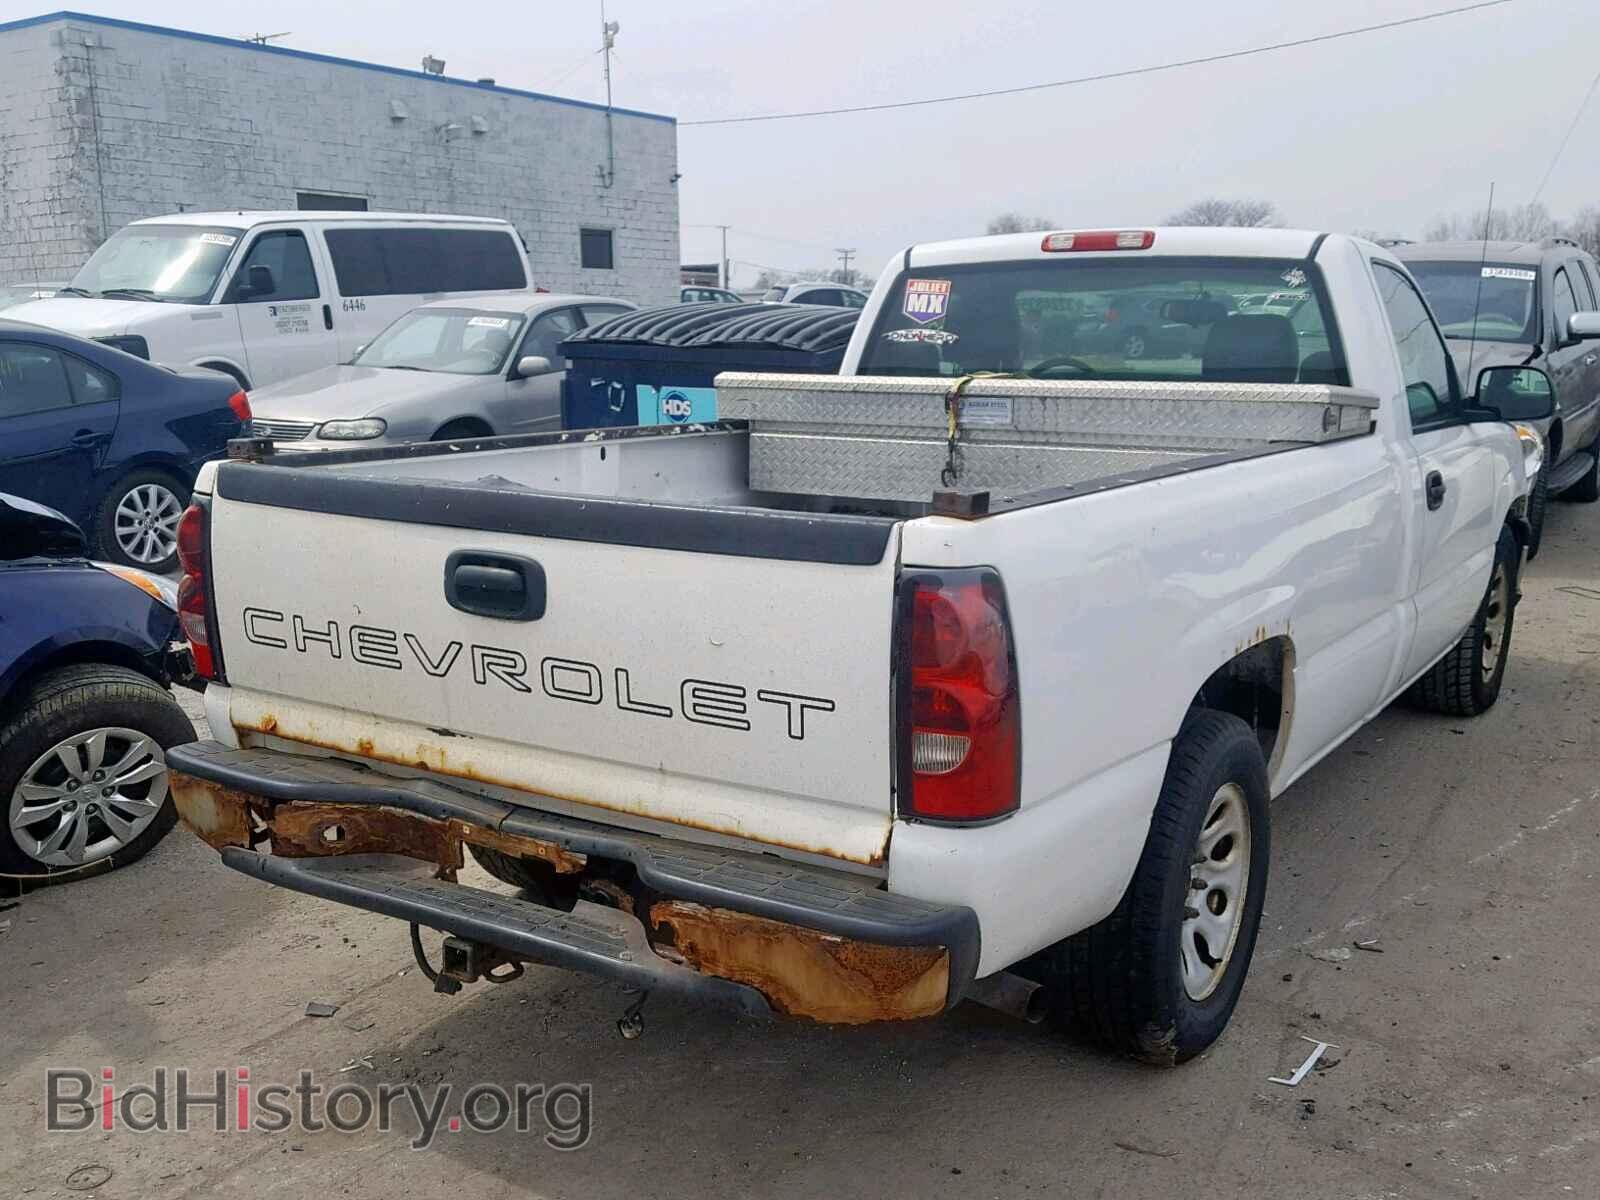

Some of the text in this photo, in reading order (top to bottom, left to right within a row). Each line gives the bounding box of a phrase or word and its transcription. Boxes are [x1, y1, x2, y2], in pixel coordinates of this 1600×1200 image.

[909, 282, 948, 292] JOLIET
[342, 299, 366, 312] 6446
[907, 293, 944, 313] MX
[662, 399, 691, 416] HDS
[243, 607, 835, 740] CHEVROLET
